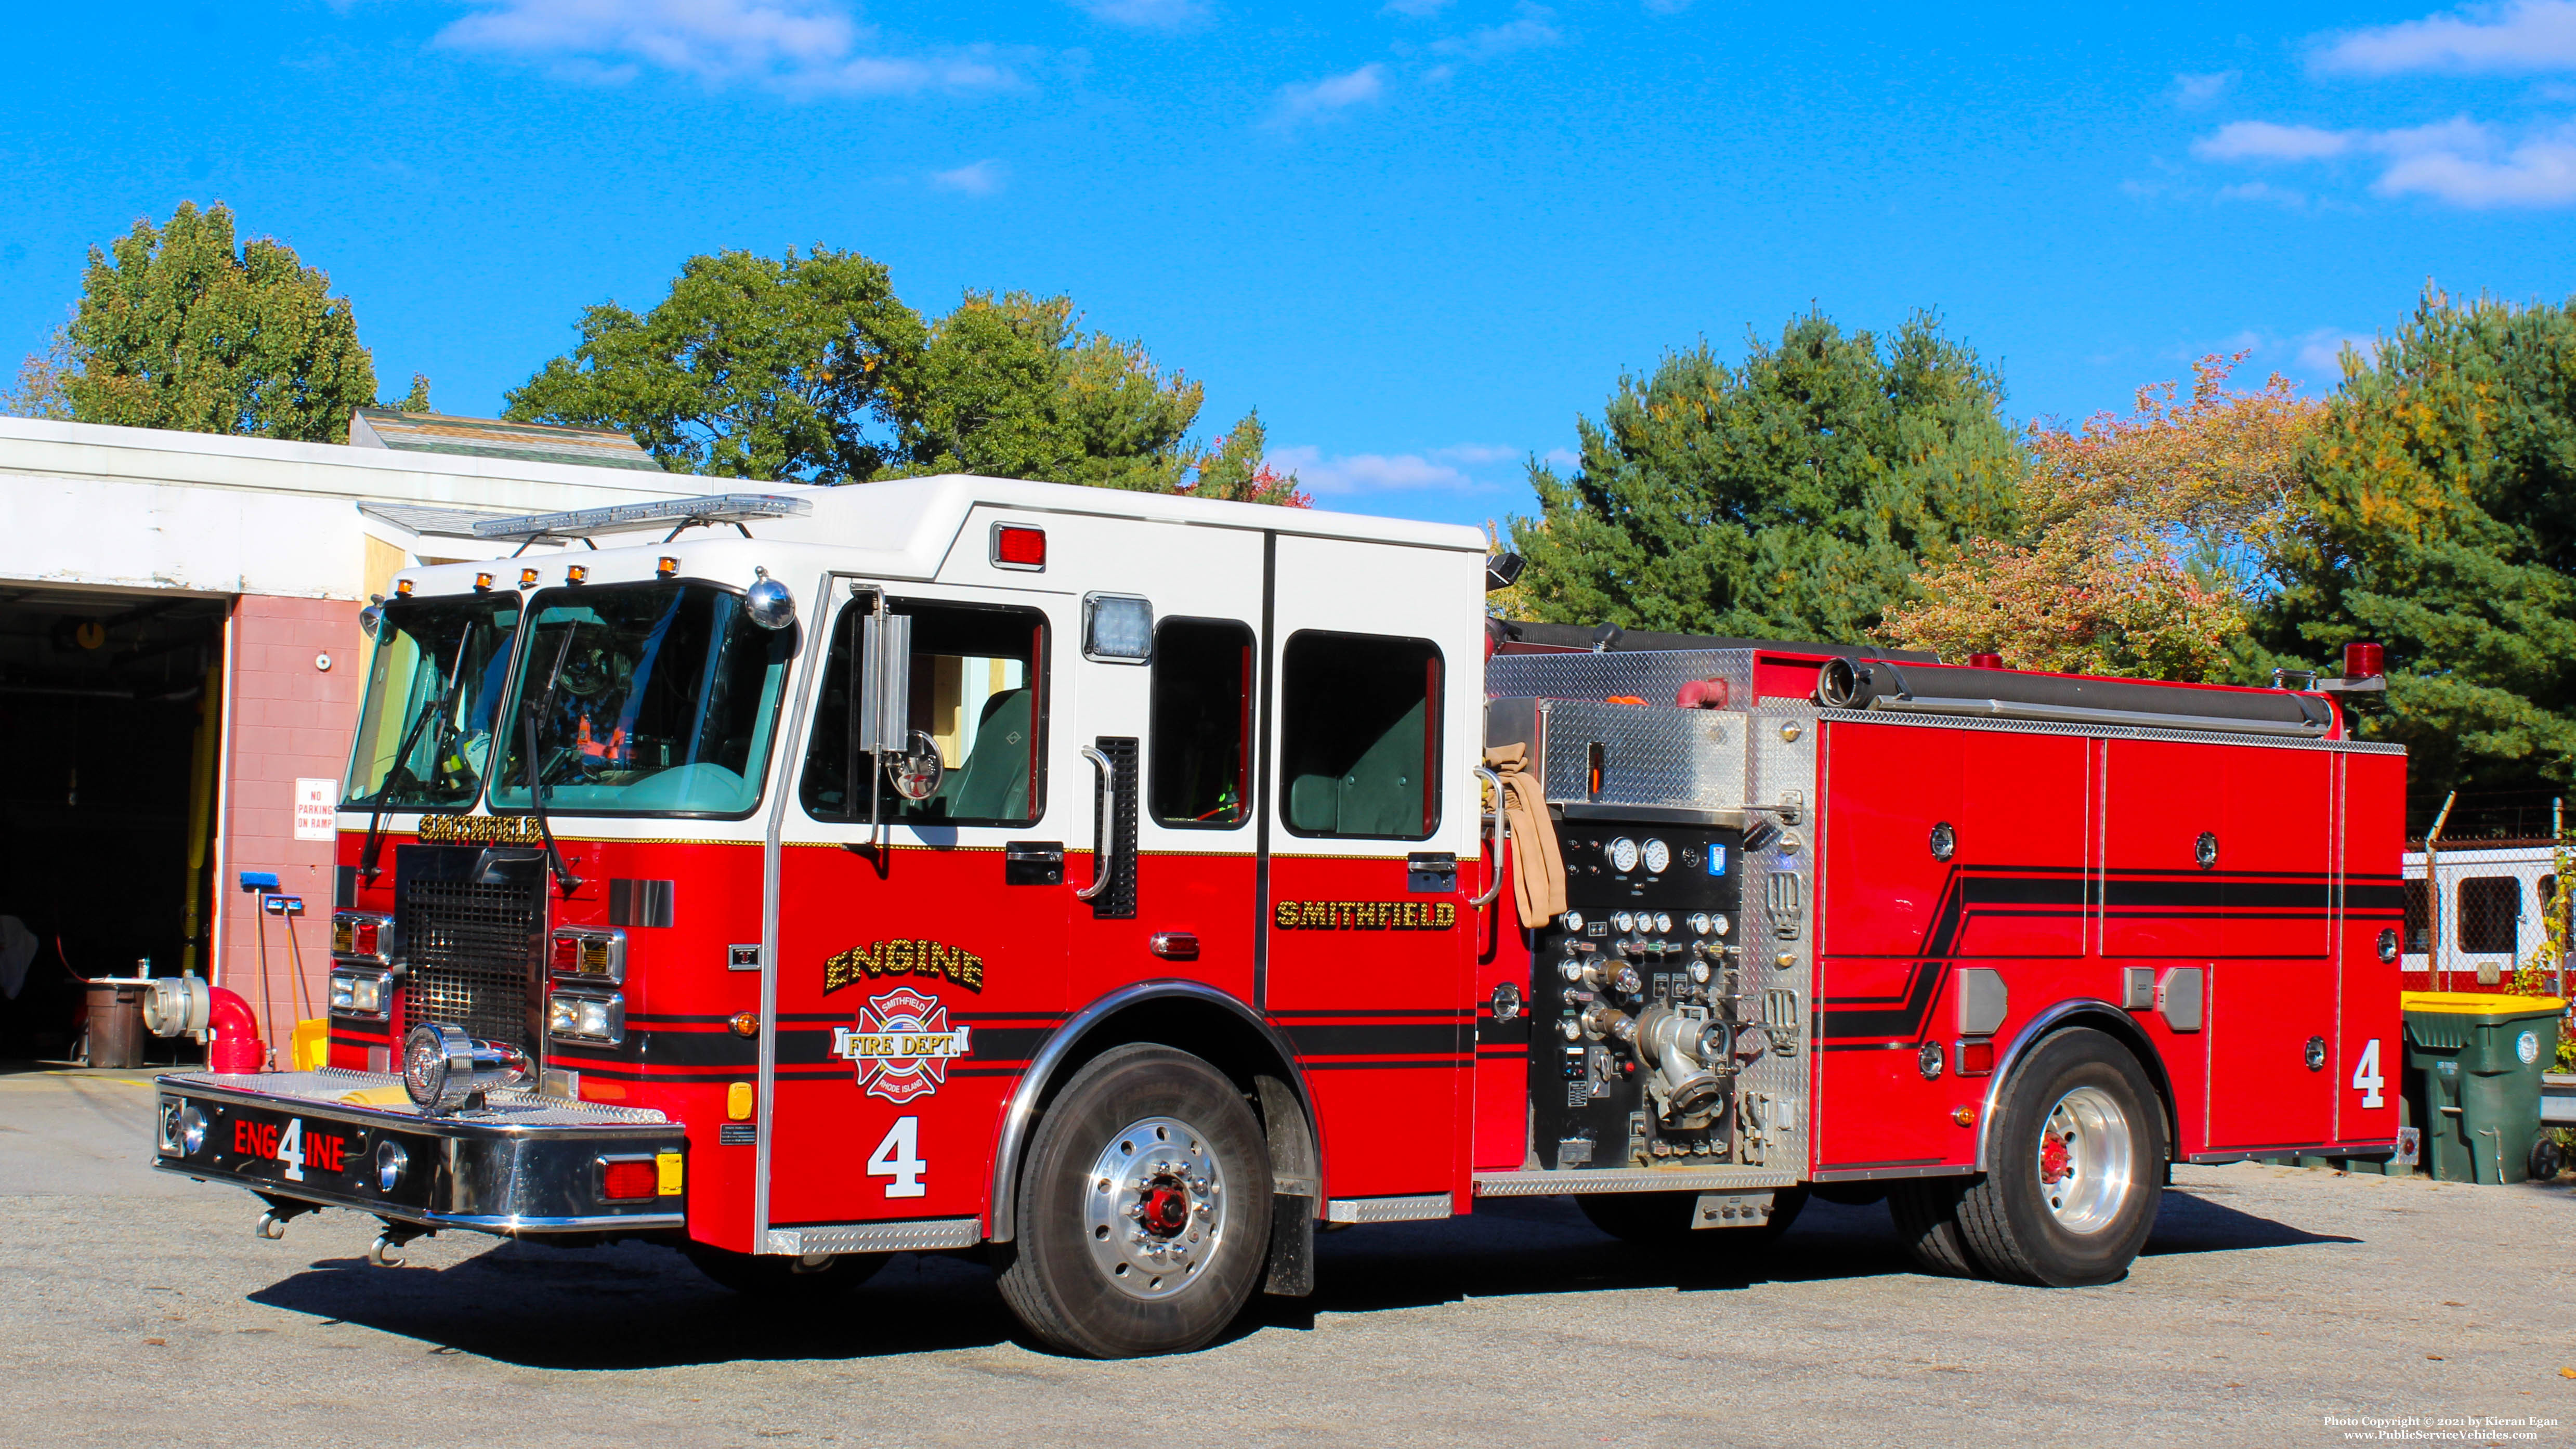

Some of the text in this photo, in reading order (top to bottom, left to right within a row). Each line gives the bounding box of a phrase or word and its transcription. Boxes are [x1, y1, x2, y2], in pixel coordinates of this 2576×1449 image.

[311, 791, 321, 801] NO
[298, 804, 333, 815] PARKING
[298, 818, 332, 828] ON RAMP
[420, 814, 542, 843] SMITHFIELD
[1276, 900, 1455, 930] SMITHFIELD
[823, 938, 983, 995] ENGINE
[882, 997, 925, 1012] SMITHFIELD
[848, 1035, 958, 1055] FIRE DEPT.
[2352, 1039, 2385, 1108] 4
[879, 1079, 923, 1093] RHODE ISLAND
[867, 1116, 926, 1198] 4
